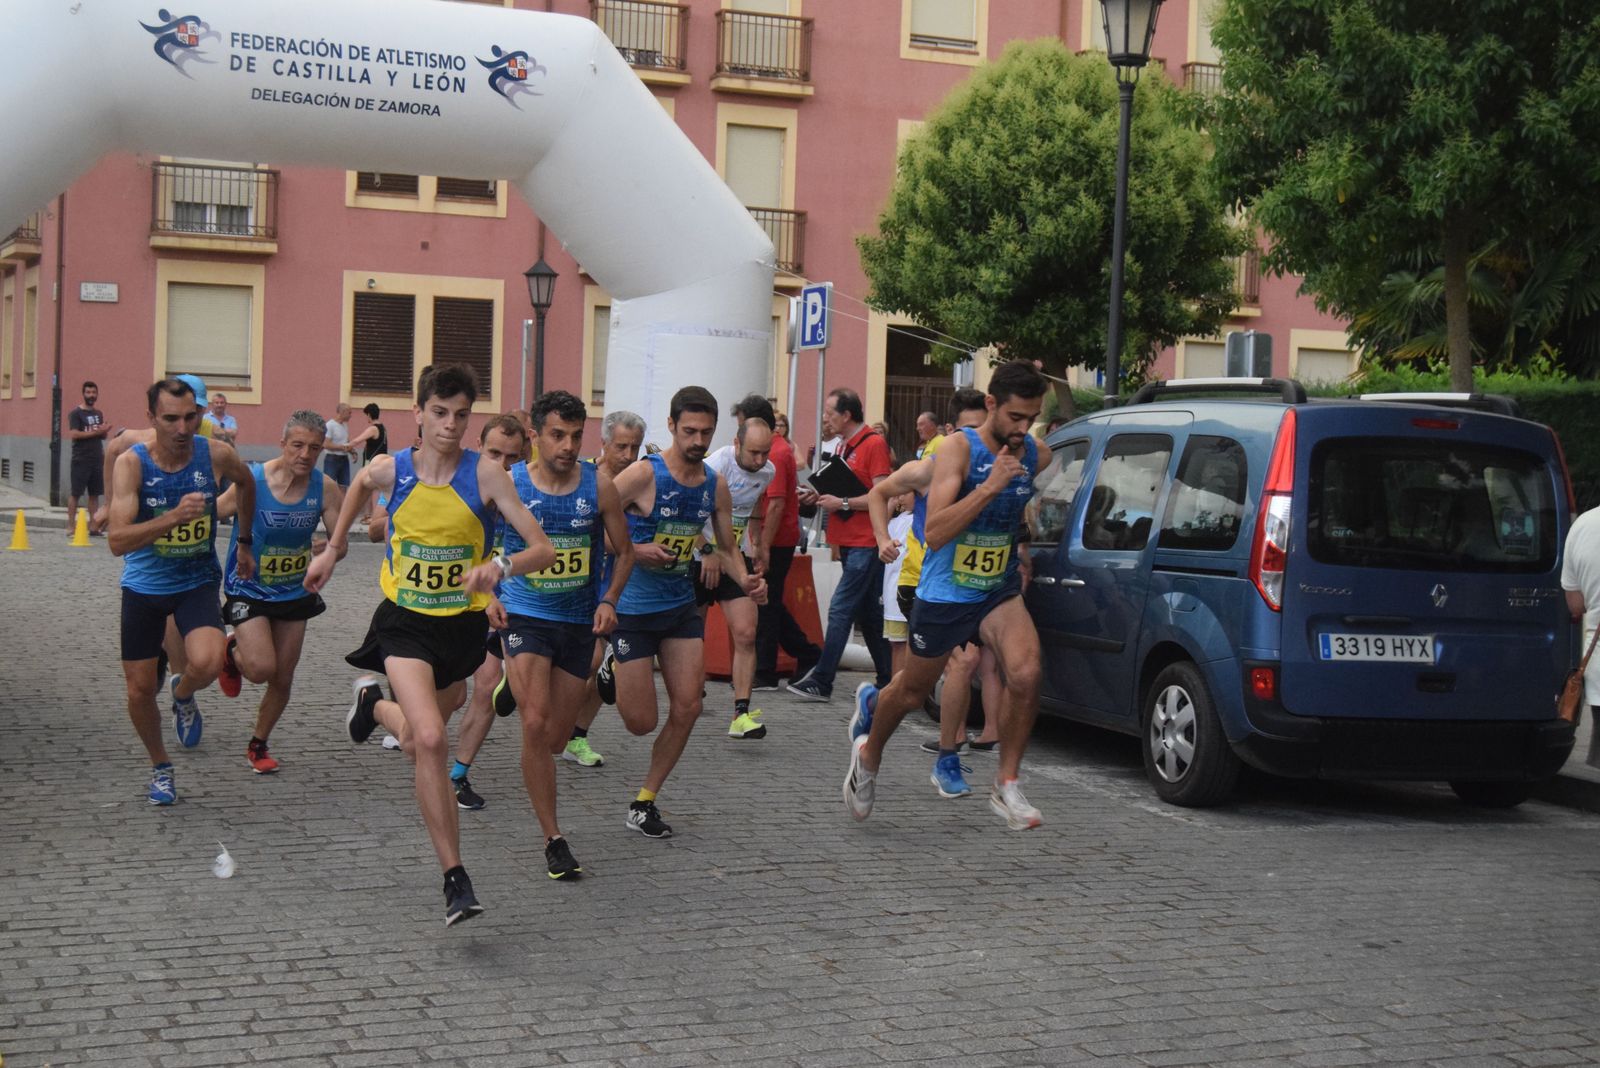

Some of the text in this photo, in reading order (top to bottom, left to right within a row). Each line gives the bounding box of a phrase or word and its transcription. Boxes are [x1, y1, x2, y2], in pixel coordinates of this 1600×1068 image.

[230, 32, 466, 71] FEDERACIÓN DE ATLETISMO
[230, 54, 465, 93] DE CASTILLA Y LEÓN
[251, 88, 441, 116] DELEGACIÓN DE ZAMORA
[805, 292, 823, 342] P
[266, 555, 306, 574] 460
[539, 550, 582, 576] 55
[962, 549, 1005, 573] 451
[406, 562, 463, 590] 458
[543, 581, 561, 589] CAJA
[418, 594, 467, 604] CAJA RURAL
[1335, 637, 1430, 658] 3319 HYX
